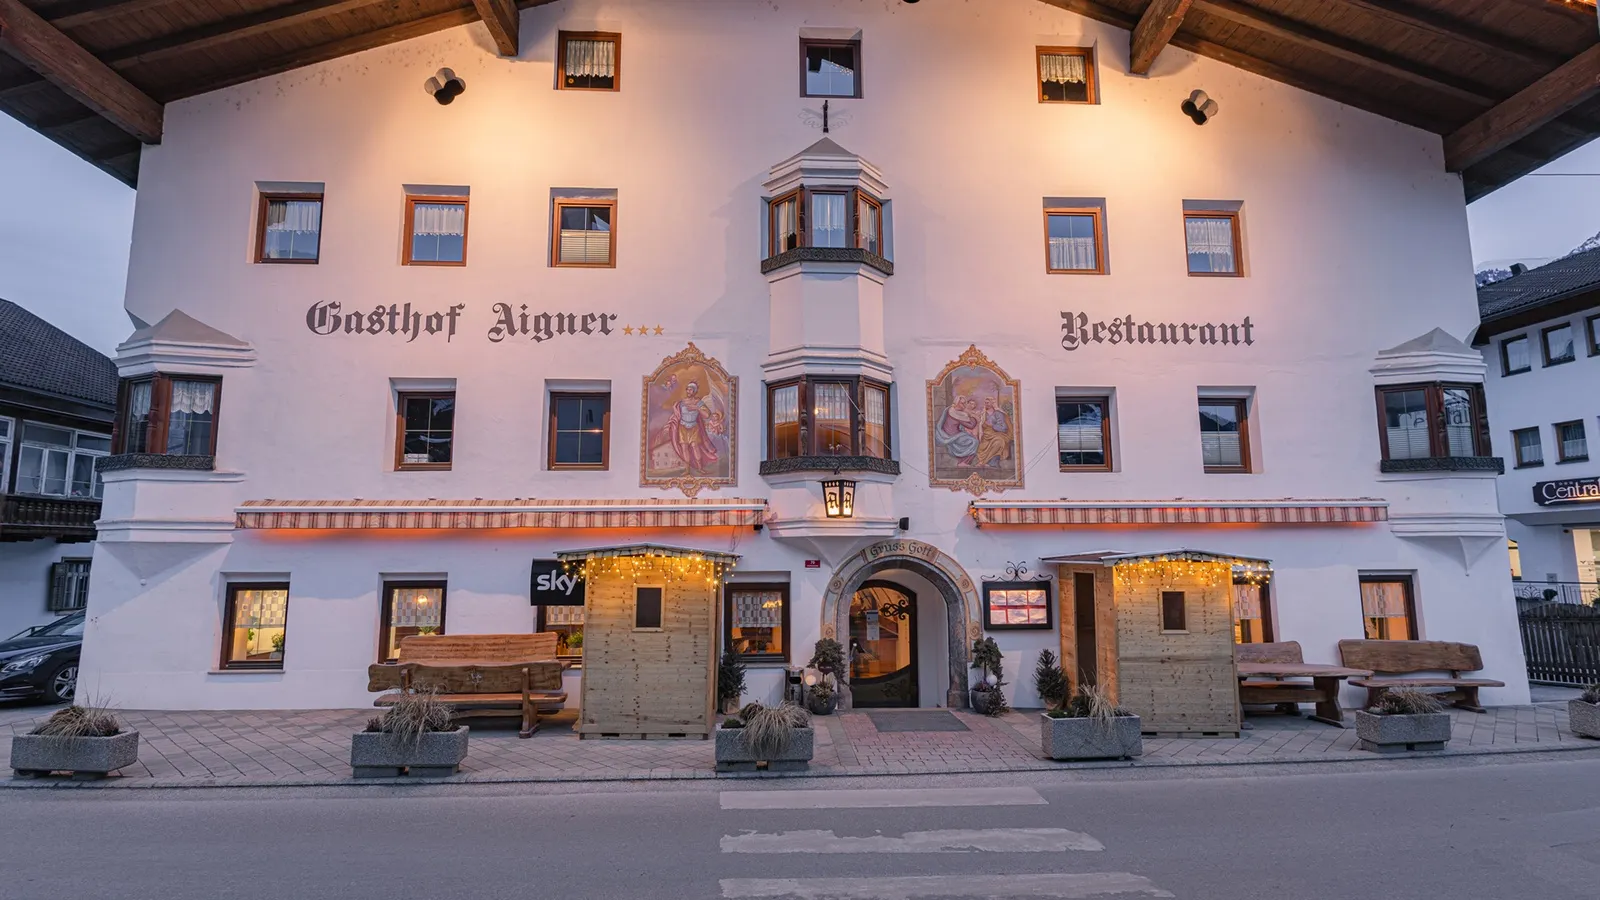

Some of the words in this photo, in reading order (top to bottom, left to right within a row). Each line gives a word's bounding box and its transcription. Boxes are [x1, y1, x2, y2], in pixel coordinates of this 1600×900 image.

[306, 300, 466, 343] Gasthof
[487, 302, 618, 343] Aigner
[1060, 310, 1255, 351] Restaurant
[908, 541, 931, 557] Gott
[536, 569, 579, 596] sky
